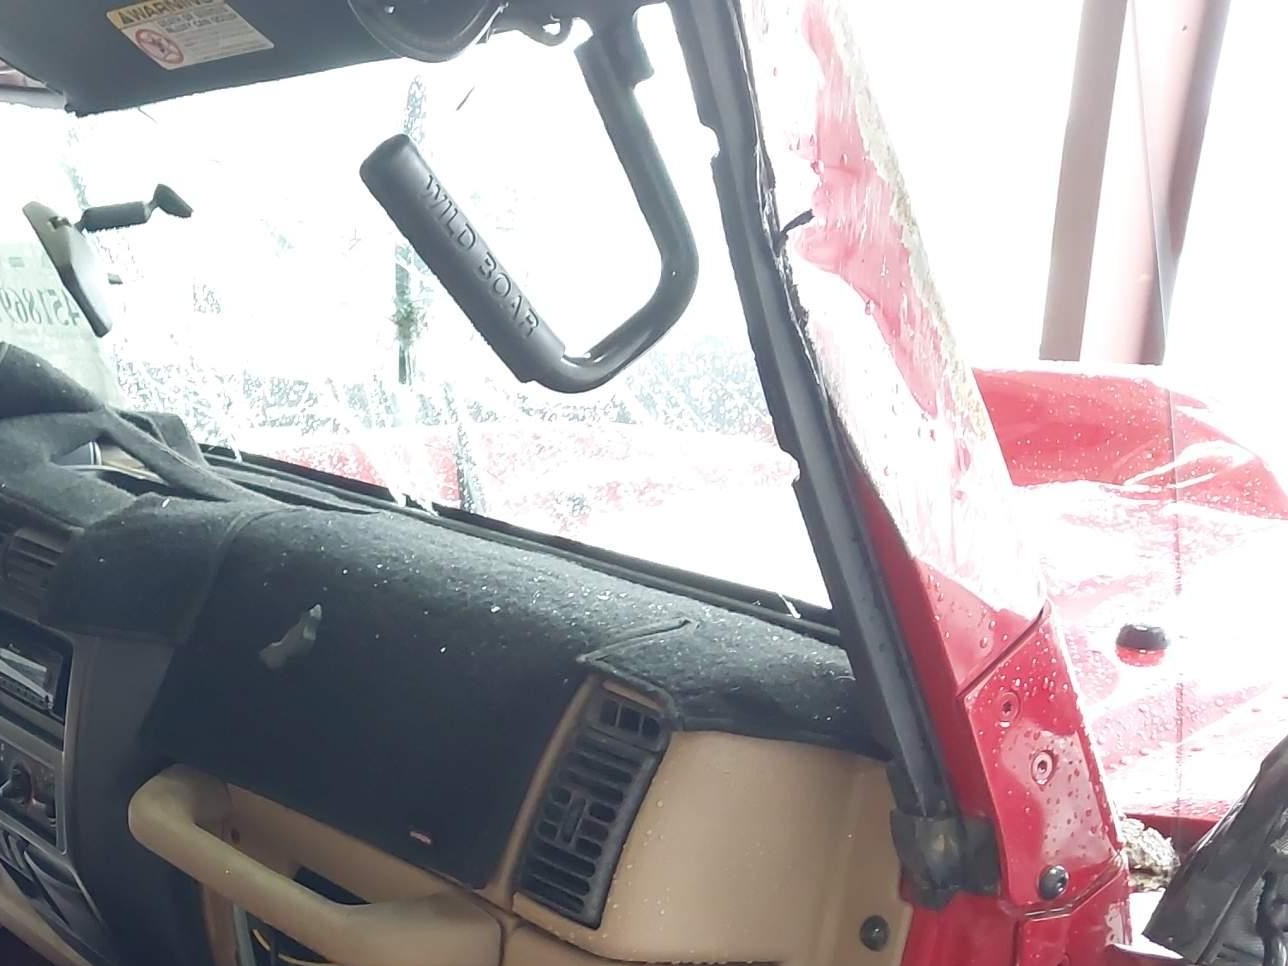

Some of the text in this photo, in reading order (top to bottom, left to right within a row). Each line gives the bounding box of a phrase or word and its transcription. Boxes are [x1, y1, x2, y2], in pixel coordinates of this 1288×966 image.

[128, 0, 215, 20] WARNIN
[423, 174, 540, 337] WILD BOAR
